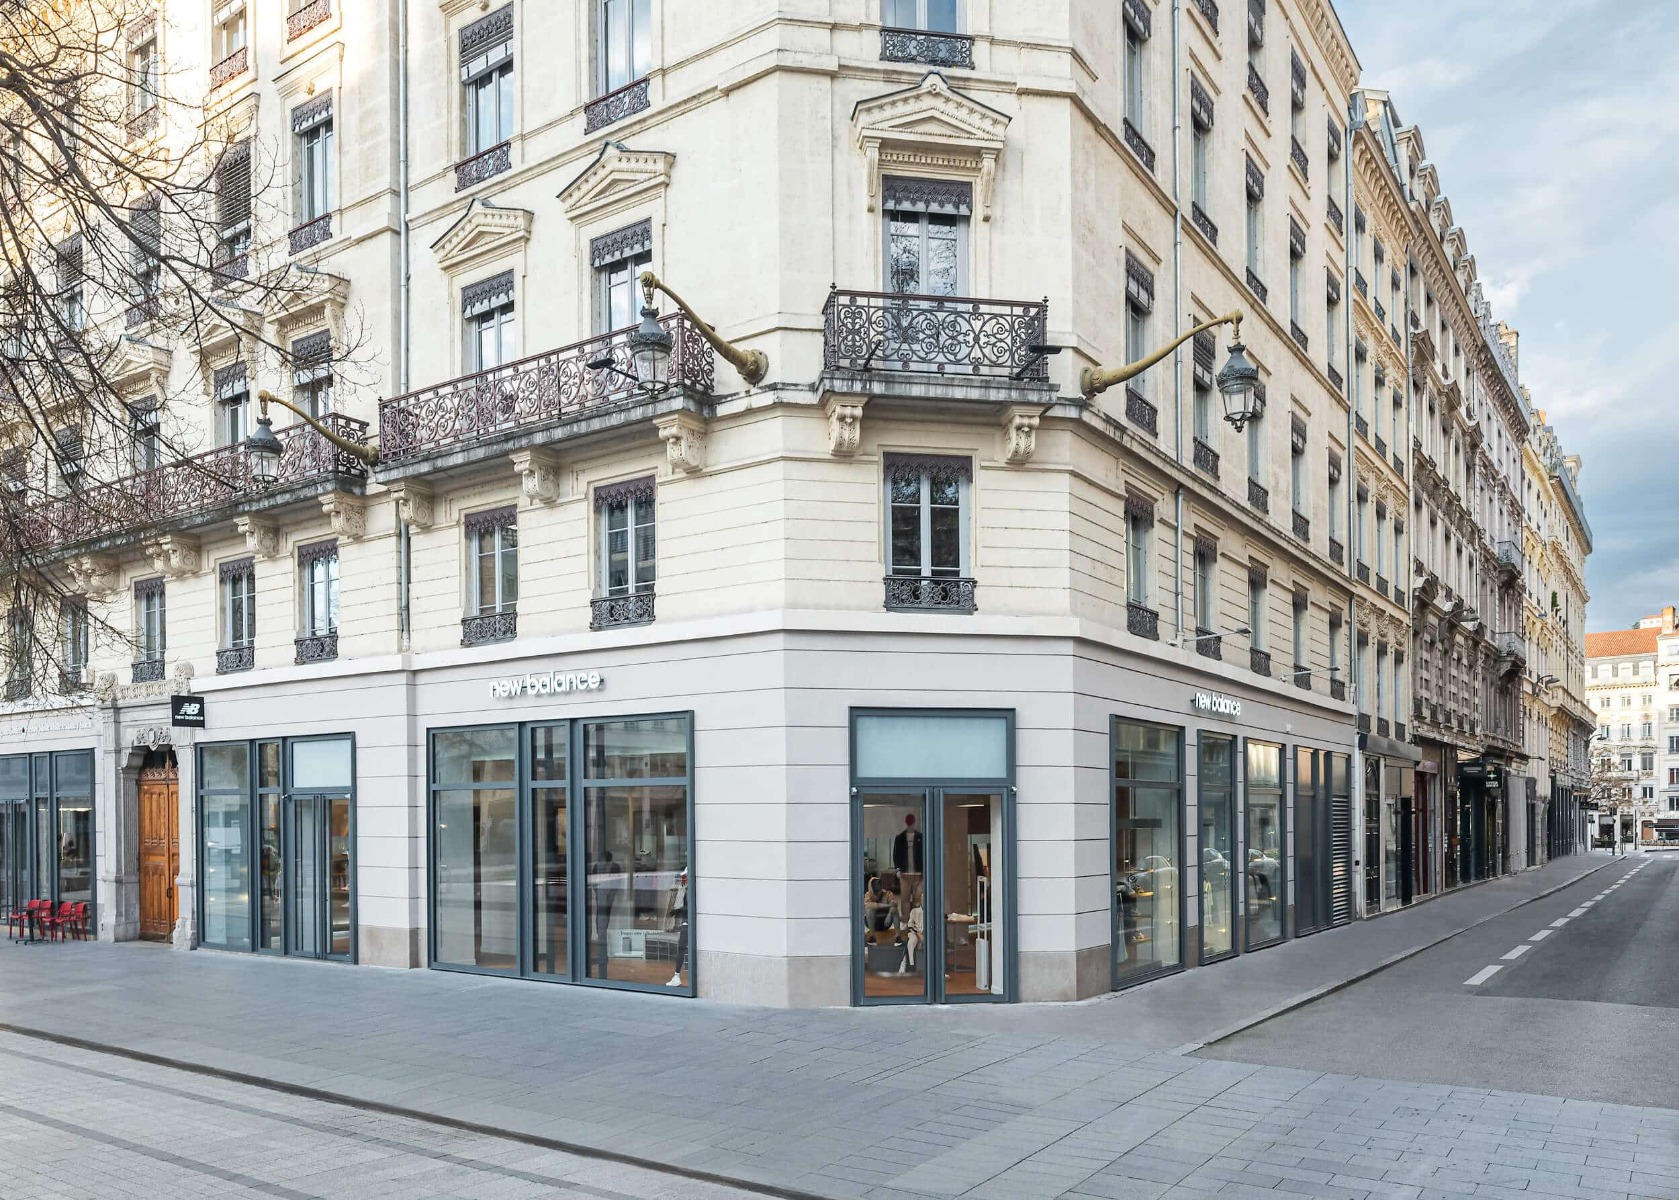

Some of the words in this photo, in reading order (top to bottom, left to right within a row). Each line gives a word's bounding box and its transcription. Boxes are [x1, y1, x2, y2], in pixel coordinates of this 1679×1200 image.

[489, 679, 523, 698] new
[527, 671, 601, 695] balance
[1195, 692, 1211, 710] new
[1212, 692, 1241, 716] balance
